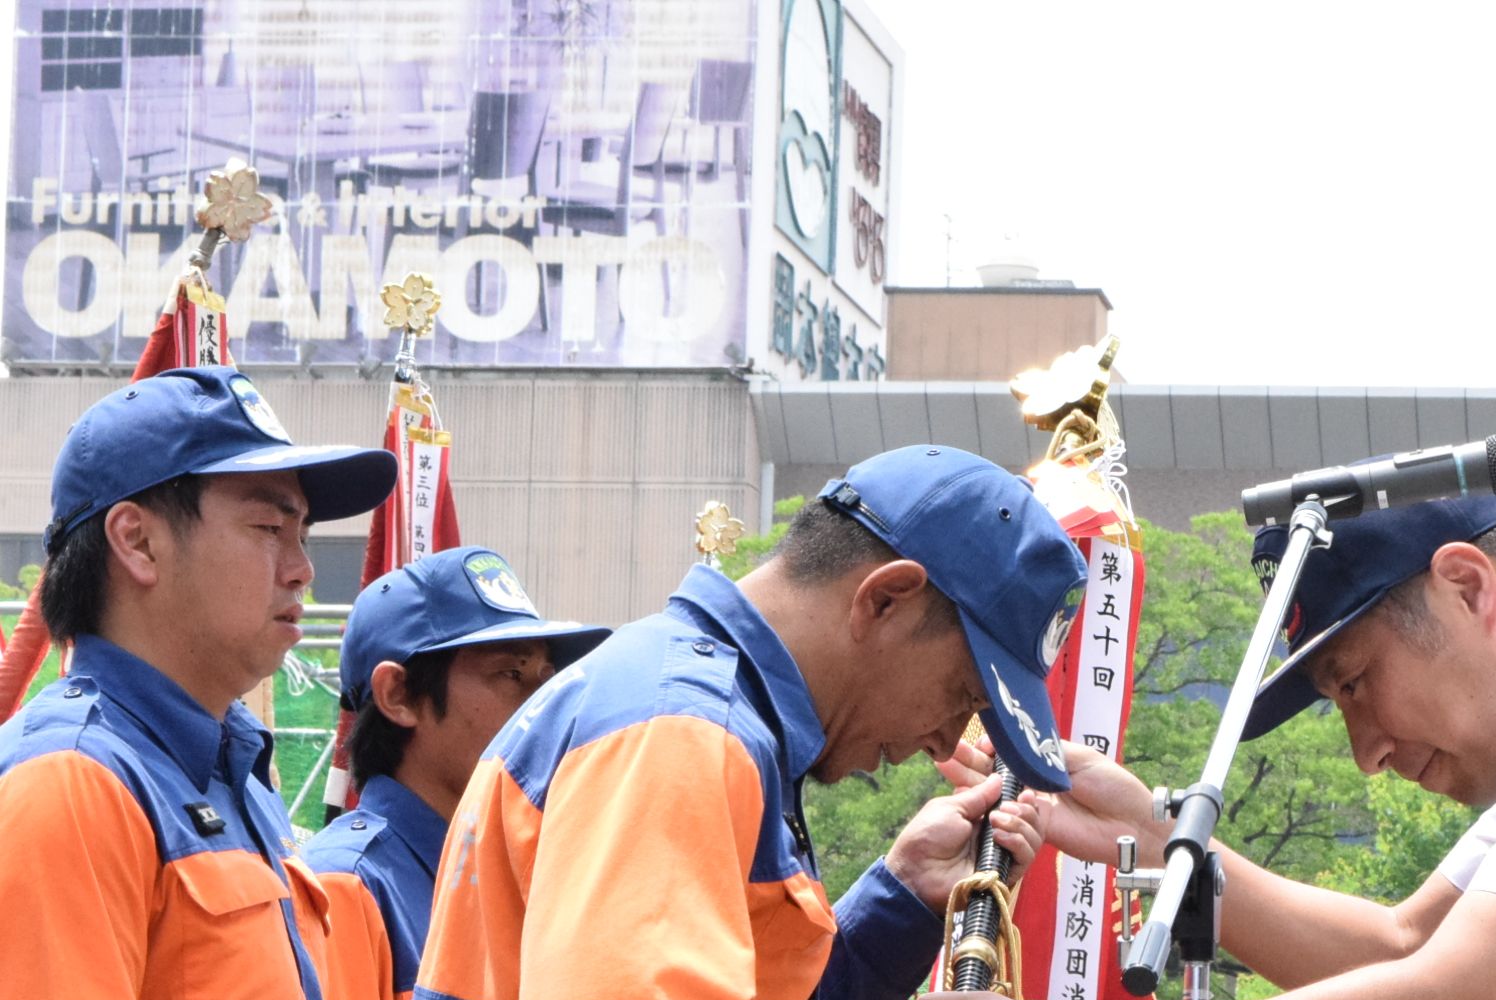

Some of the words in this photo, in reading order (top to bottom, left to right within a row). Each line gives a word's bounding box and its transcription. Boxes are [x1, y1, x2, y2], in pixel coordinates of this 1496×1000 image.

[32, 177, 285, 227] Furnite
[339, 180, 547, 229] Interior
[22, 230, 727, 343] OKAMOTO
[414, 455, 432, 508] 第三位
[1092, 551, 1122, 692] 第五十回
